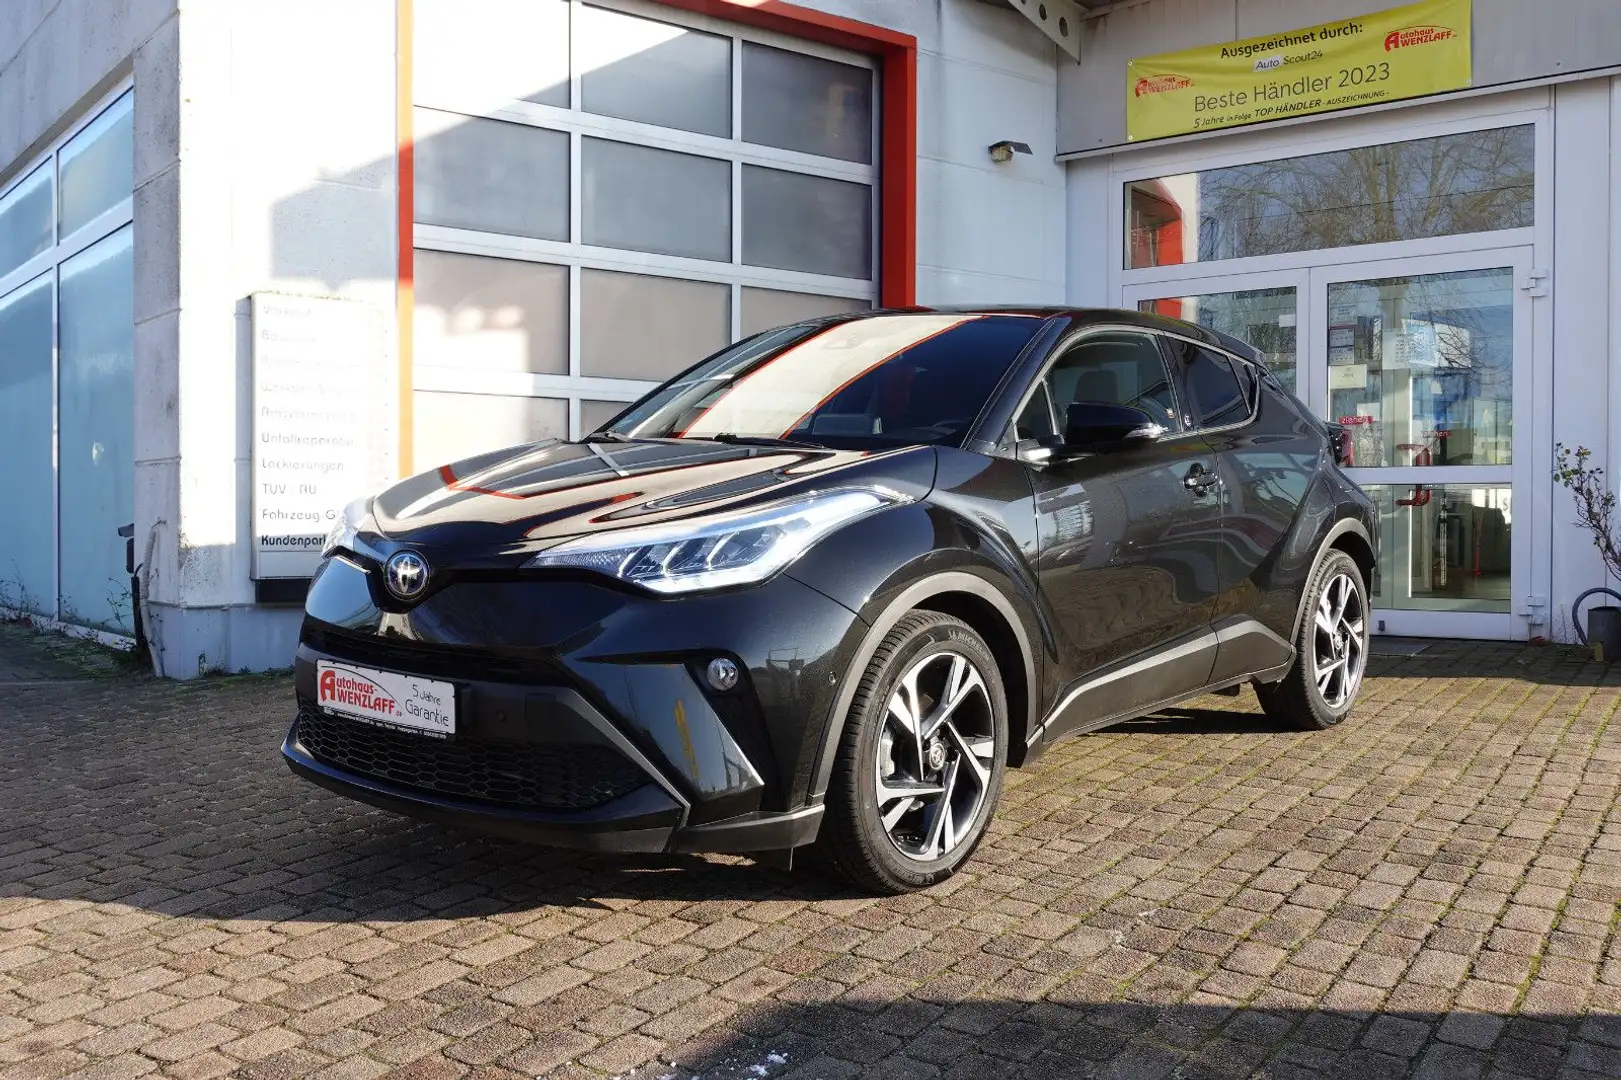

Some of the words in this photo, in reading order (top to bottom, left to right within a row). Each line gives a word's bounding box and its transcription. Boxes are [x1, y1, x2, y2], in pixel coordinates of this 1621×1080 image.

[1220, 31, 1316, 58] Ausgezeichnet
[1319, 22, 1363, 40] durch:
[1384, 27, 1435, 51] Autohaus
[1400, 30, 1452, 47] WENZLAFF
[1255, 58, 1280, 71] Auto
[1283, 50, 1323, 65] Scout24
[1194, 90, 1248, 112] Beste
[1254, 75, 1333, 103] Händler
[1338, 62, 1390, 88] 2023
[1194, 118, 1200, 129] 5
[1201, 115, 1224, 126] Jahre
[1233, 112, 1252, 121] Folge
[1255, 107, 1274, 118] TOP
[1275, 99, 1322, 114] HÄNDLER
[1327, 91, 1385, 105] AUSZEICHNUNG
[262, 457, 344, 475] Lackierungen
[262, 508, 321, 523] Fahrzeug
[337, 688, 396, 715] WENZLAFF
[412, 683, 419, 698] 5
[420, 688, 441, 706] Jahre
[405, 698, 450, 727] Garantie
